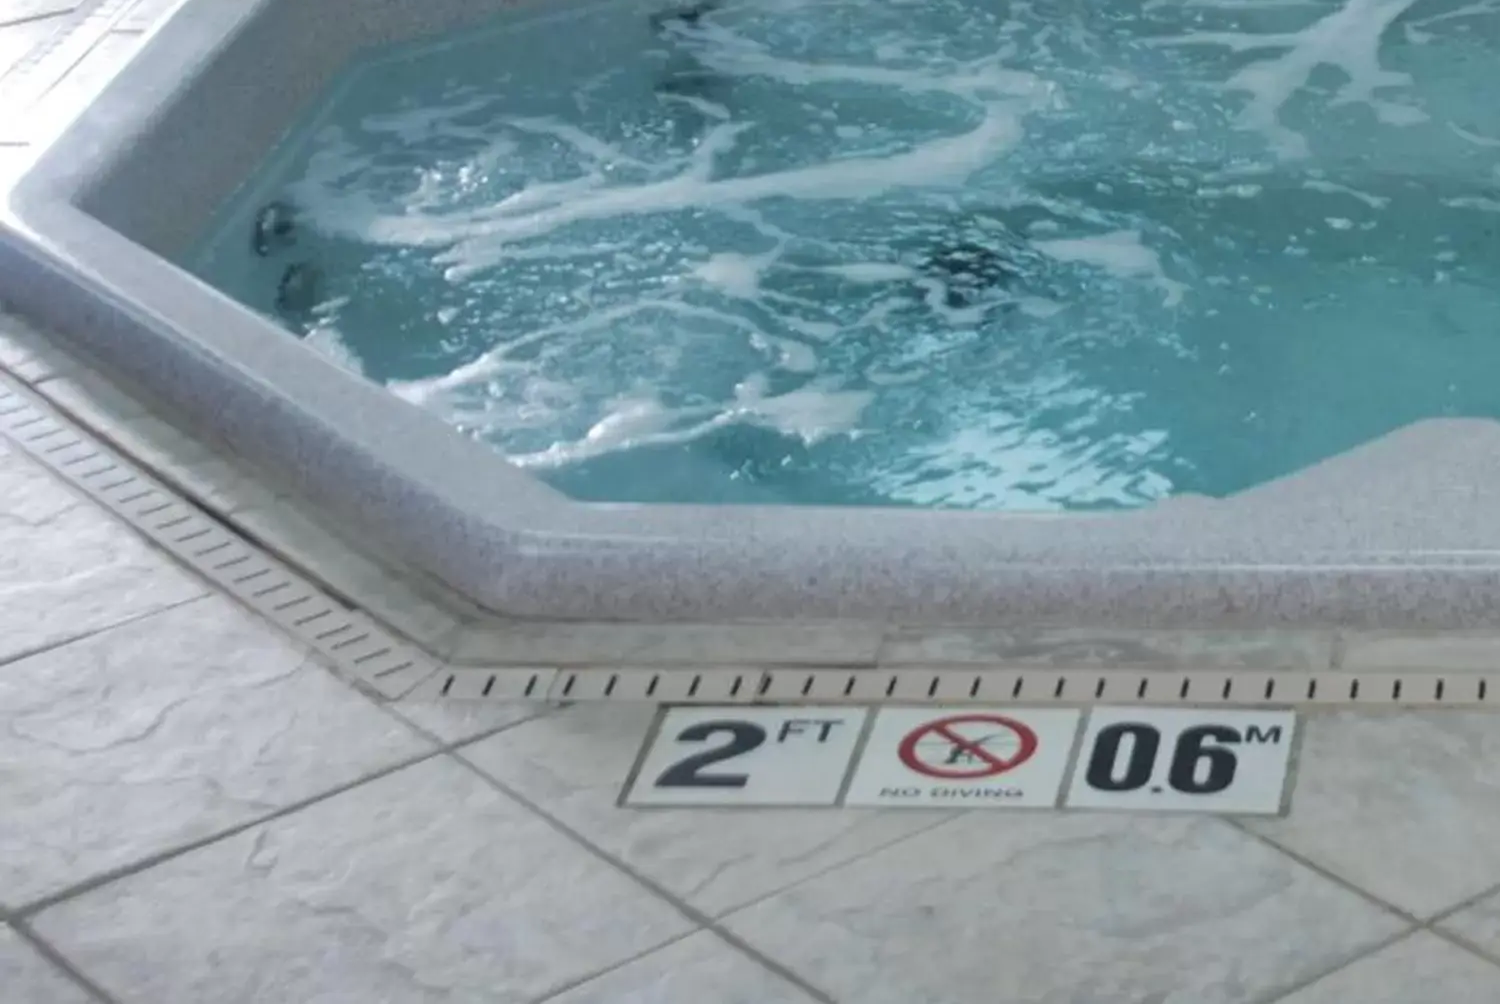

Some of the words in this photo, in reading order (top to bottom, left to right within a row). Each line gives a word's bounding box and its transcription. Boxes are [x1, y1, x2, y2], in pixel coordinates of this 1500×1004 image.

[653, 719, 767, 788] 2
[777, 718, 845, 743] FT
[1084, 721, 1242, 795] 0.6
[1244, 724, 1283, 744] M
[878, 787, 921, 798] NO
[929, 787, 1025, 799] DIVING
